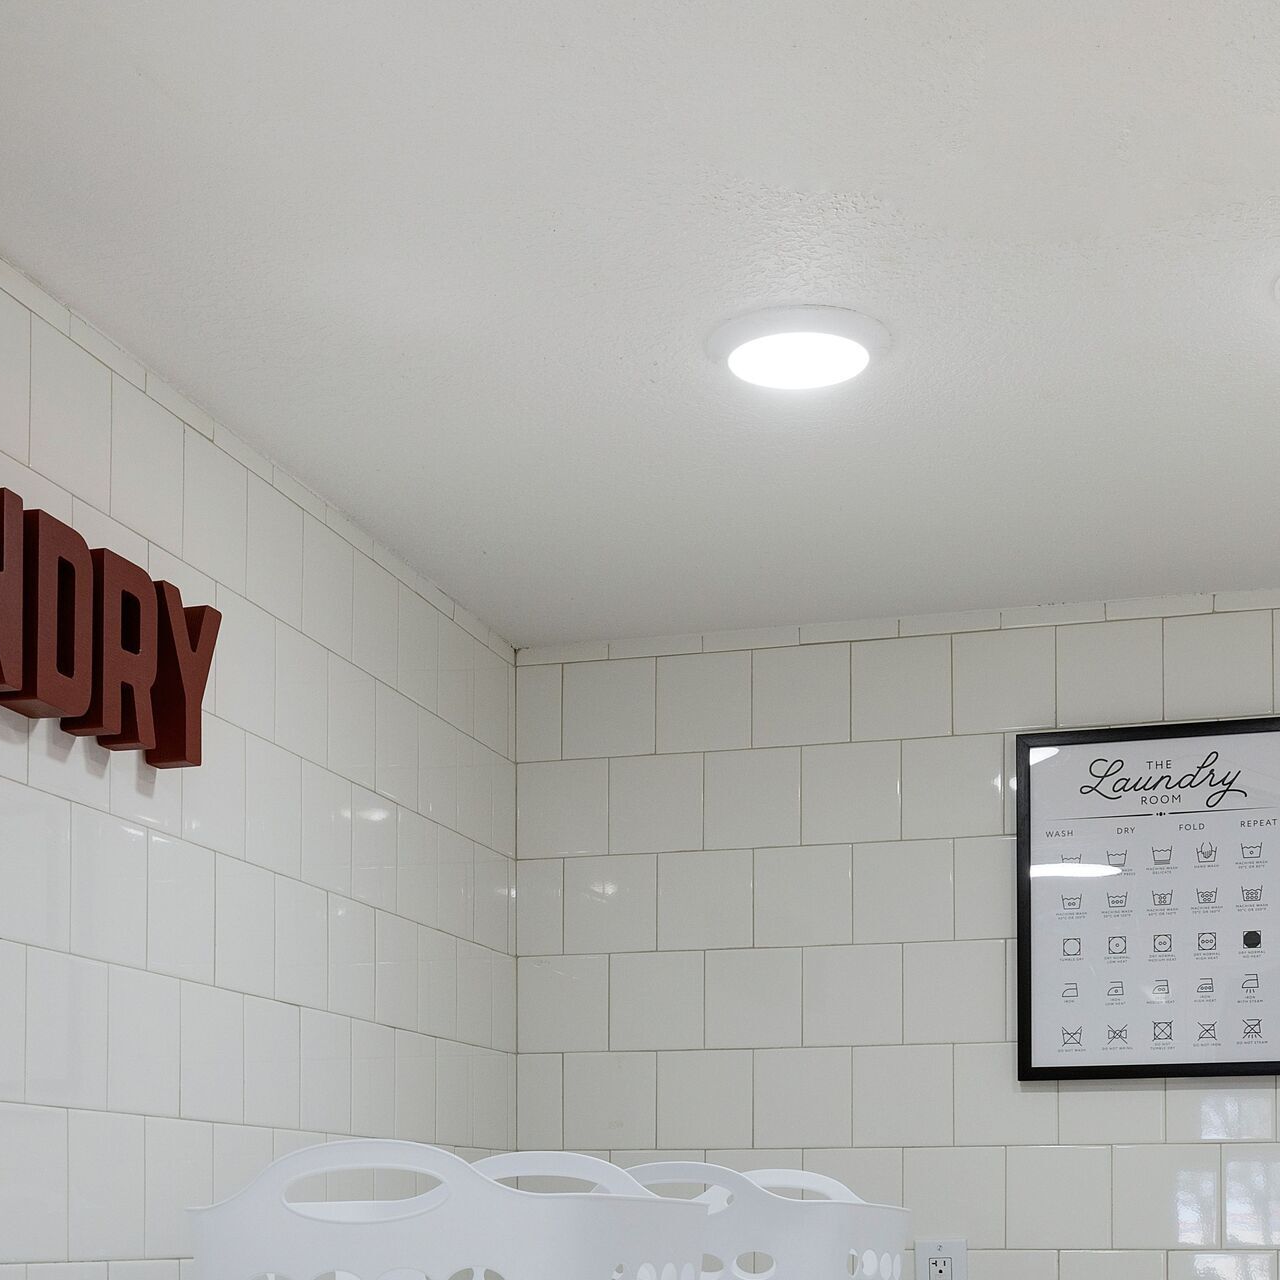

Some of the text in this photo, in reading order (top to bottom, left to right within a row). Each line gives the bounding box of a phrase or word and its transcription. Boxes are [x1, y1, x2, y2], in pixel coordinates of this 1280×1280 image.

[1146, 760, 1173, 770] THE
[1079, 751, 1248, 808] Laundry
[1140, 794, 1182, 806] ROOM
[1178, 822, 1206, 831] FOLD
[1240, 818, 1278, 828] REPEAT
[1045, 829, 1074, 838] WASH
[1116, 826, 1136, 835] DRY
